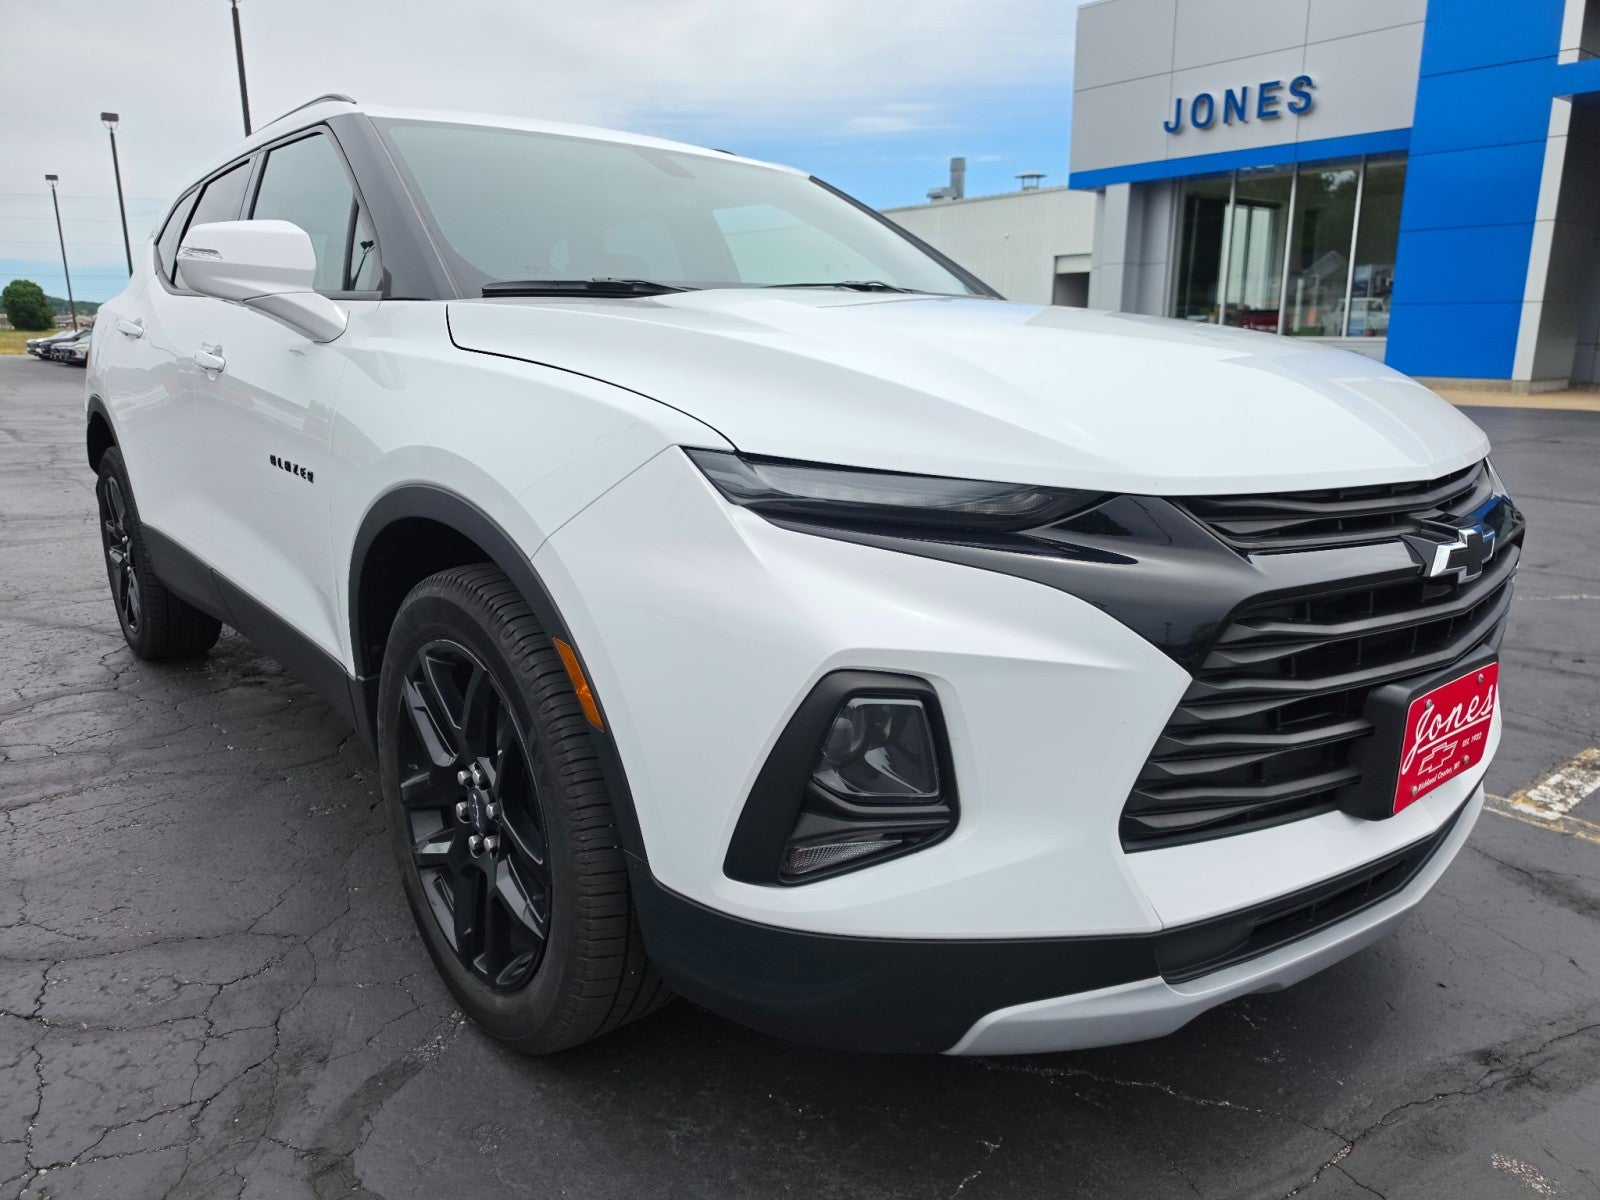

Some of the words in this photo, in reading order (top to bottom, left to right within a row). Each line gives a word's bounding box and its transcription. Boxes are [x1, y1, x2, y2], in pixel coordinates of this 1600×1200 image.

[1163, 74, 1316, 133] JONES
[269, 454, 314, 484] BLAZER
[1402, 684, 1493, 775] Jones
